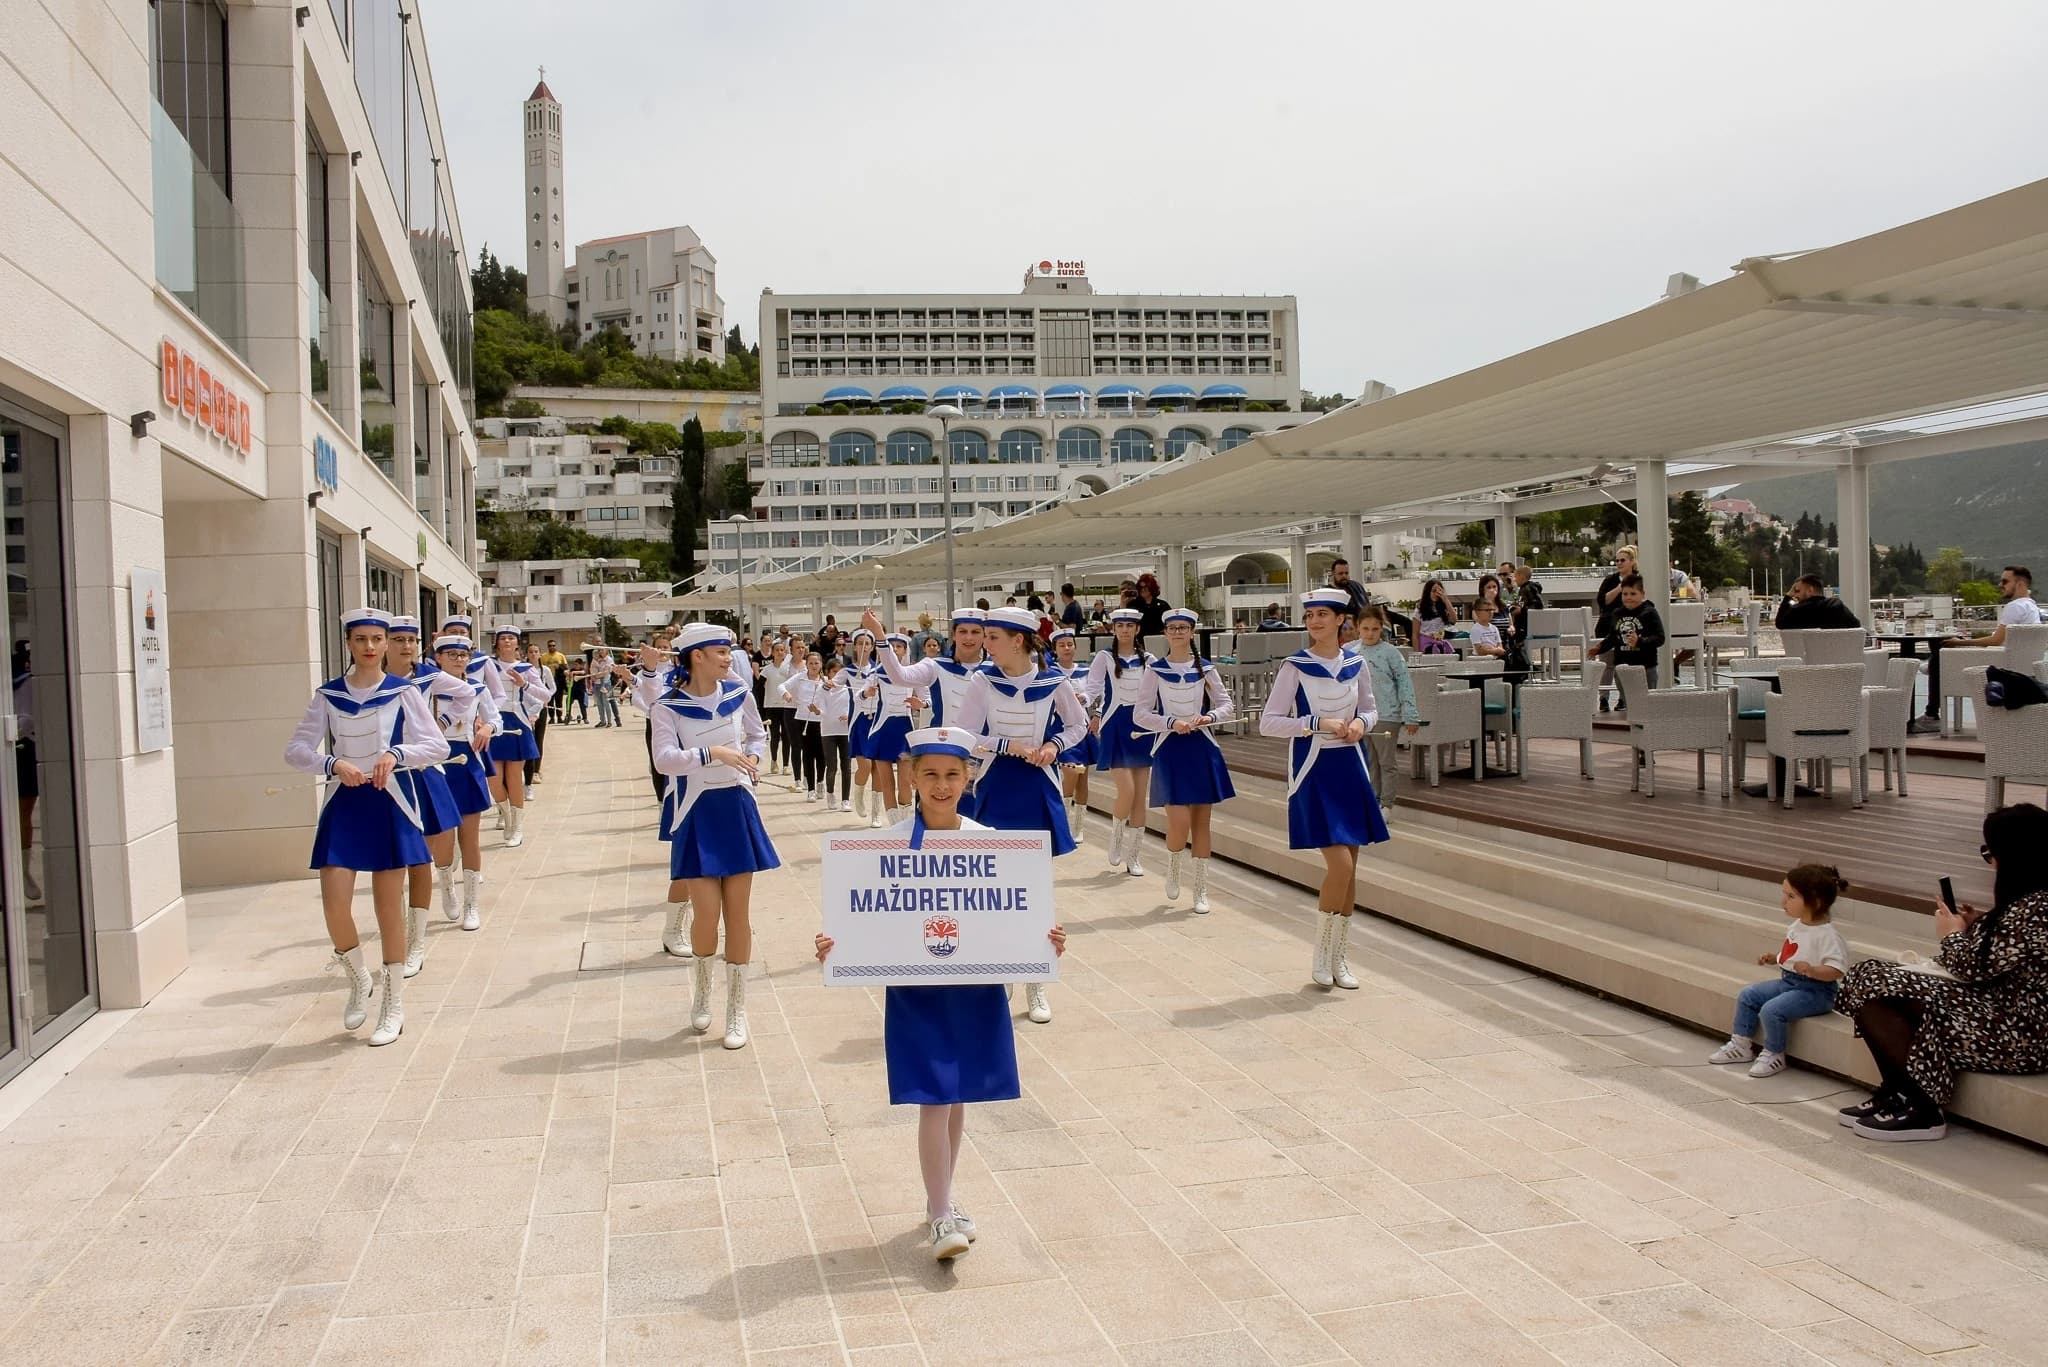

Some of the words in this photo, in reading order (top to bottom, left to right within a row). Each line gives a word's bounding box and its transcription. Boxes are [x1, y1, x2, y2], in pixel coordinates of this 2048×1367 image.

[1057, 260, 1083, 268] hotel
[142, 636, 160, 651] HOTEL
[880, 855, 996, 878] NEUMSKE
[850, 884, 1028, 913] MAŽORETKINJE
